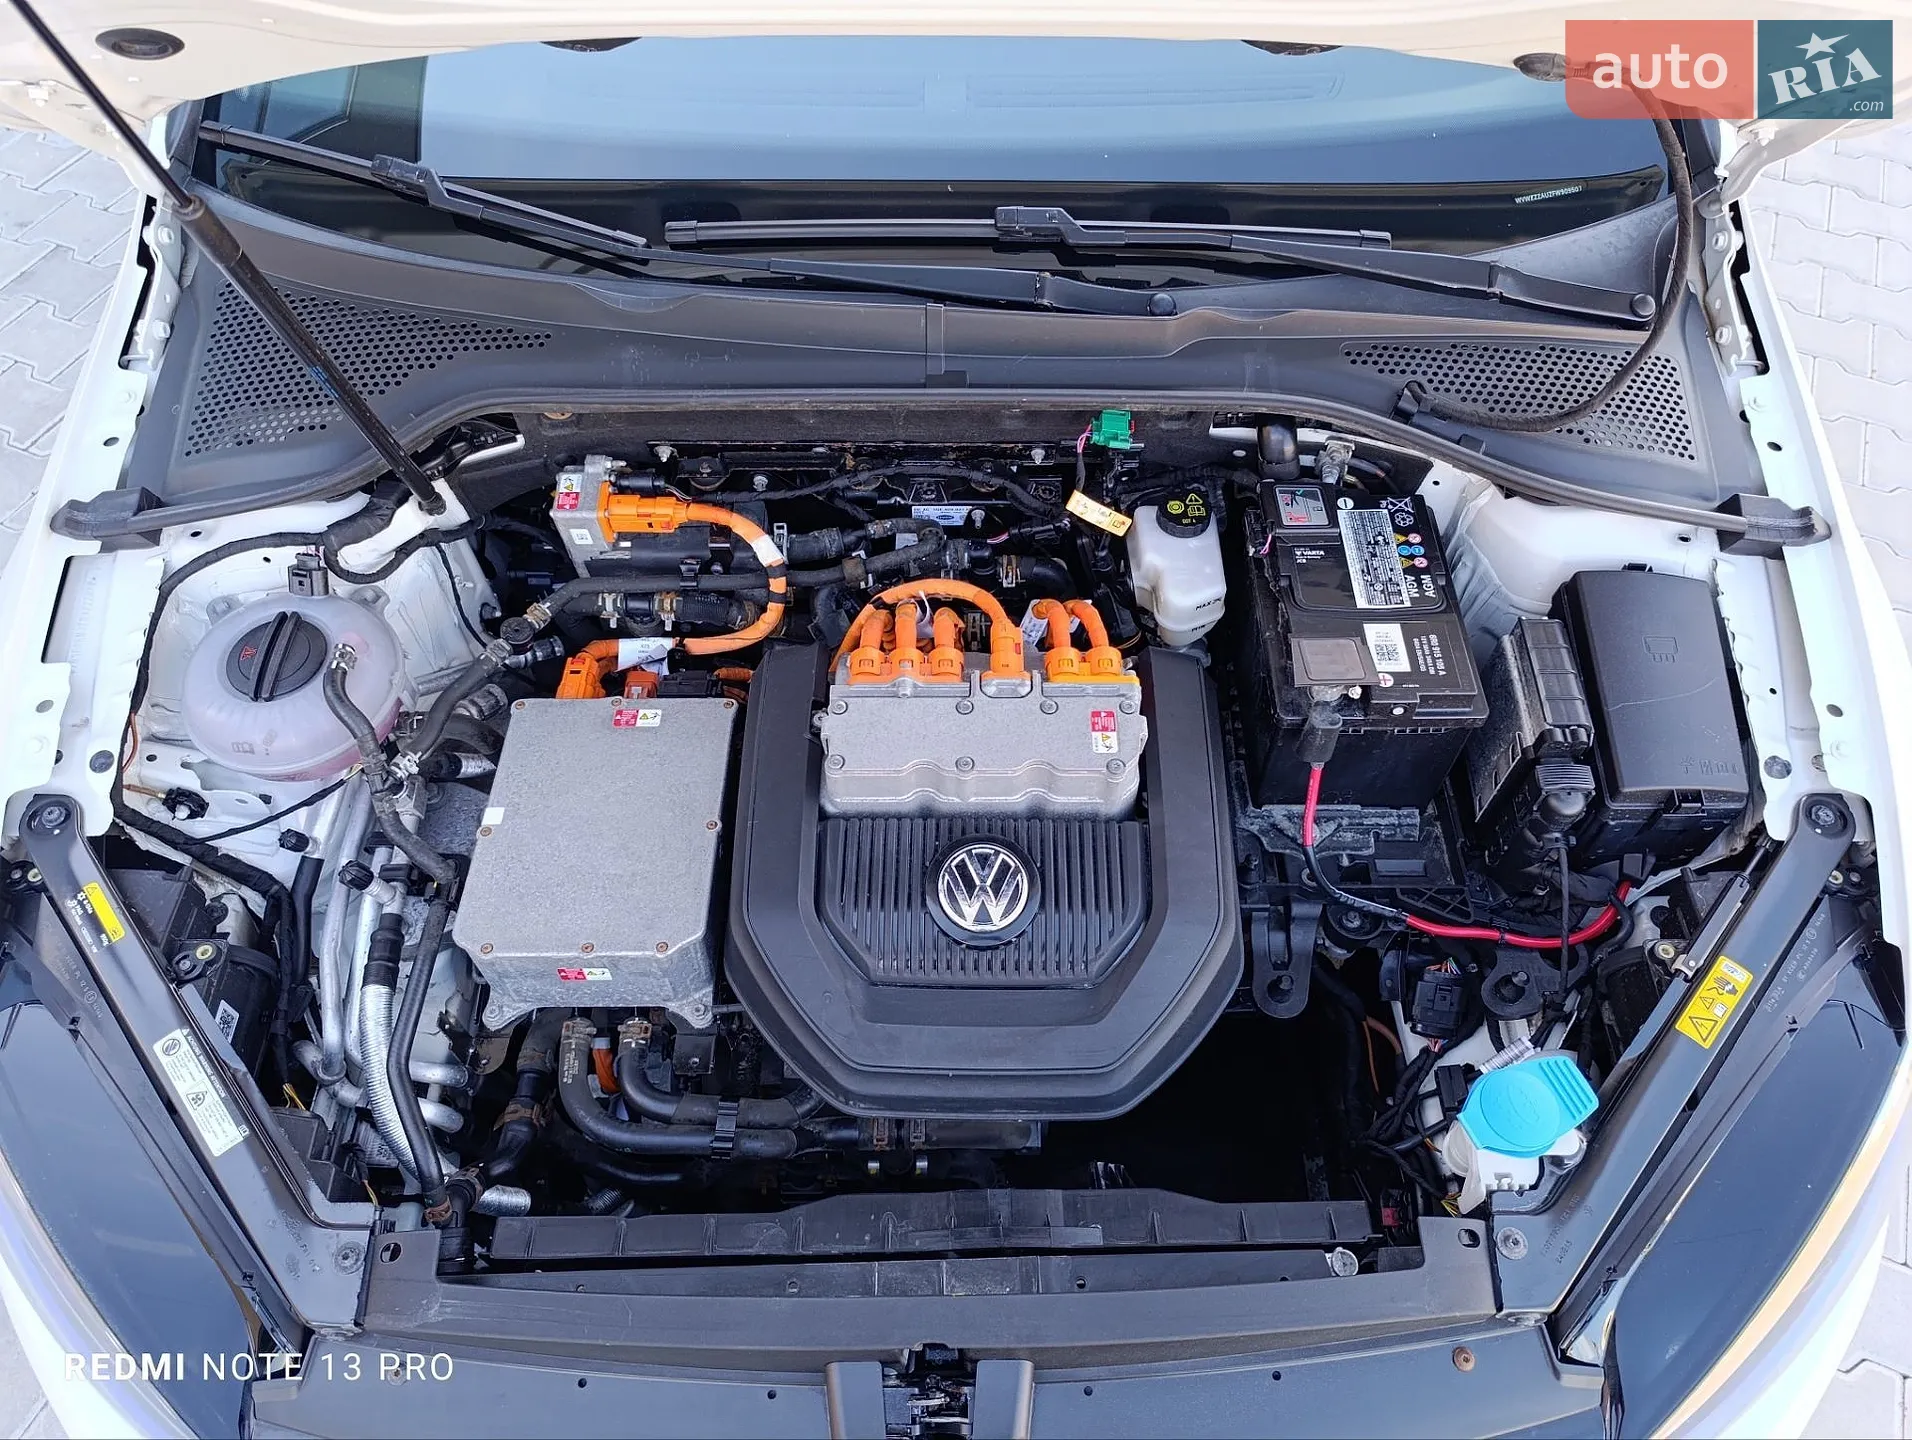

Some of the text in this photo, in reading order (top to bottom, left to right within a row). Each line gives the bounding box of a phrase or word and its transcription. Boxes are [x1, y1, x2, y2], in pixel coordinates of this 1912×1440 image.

[1404, 574, 1420, 597] AGM
[1420, 574, 1437, 598] AGM
[1195, 600, 1212, 610] MAX
[1432, 646, 1442, 658] 915
[187, 1035, 202, 1056] ACHTUNG
[199, 1055, 213, 1076] WARNING
